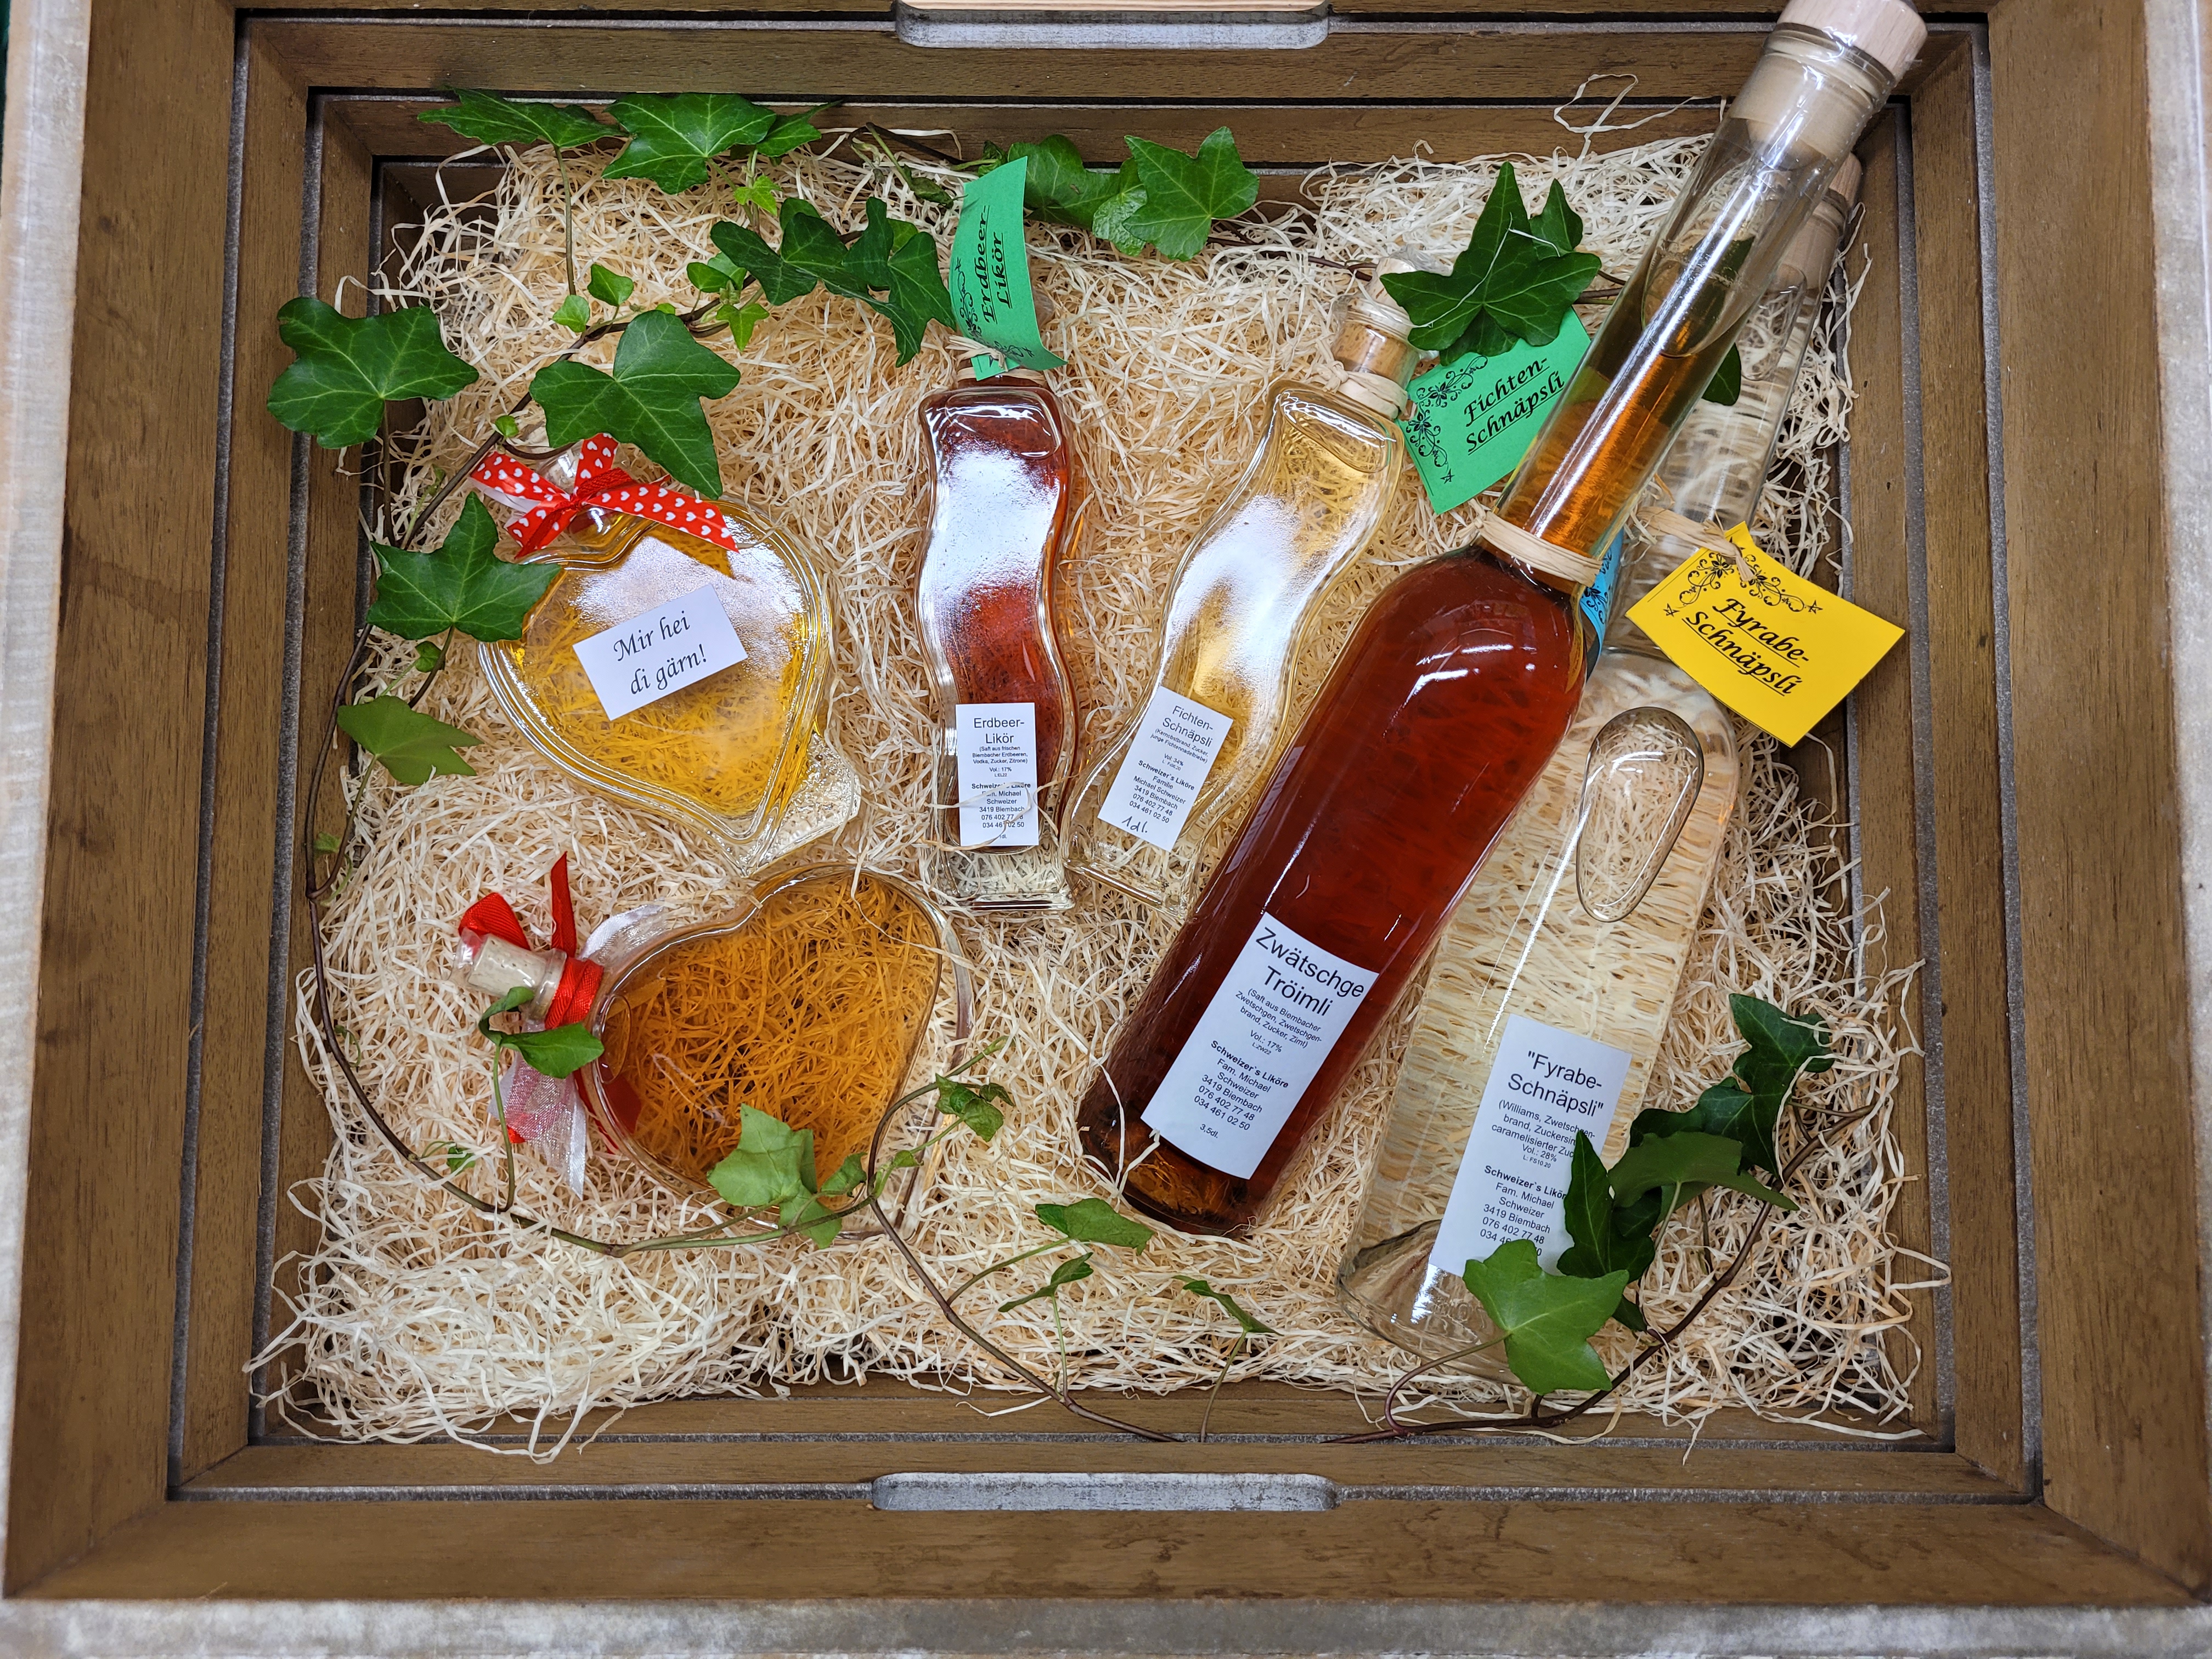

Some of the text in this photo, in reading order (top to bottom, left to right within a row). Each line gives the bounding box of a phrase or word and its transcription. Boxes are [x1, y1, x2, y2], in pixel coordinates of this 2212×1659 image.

[974, 205, 995, 324] Erdbeer-
[991, 232, 1010, 308] Likör
[1464, 358, 1547, 427] Fichten-
[1466, 370, 1565, 452] Schnäpsli
[613, 610, 691, 661] Mir hei
[1712, 597, 1809, 662] Fyrabe-
[1685, 611, 1803, 695] Schnäpsli
[630, 644, 707, 695] di gärn!
[974, 718, 1024, 728] Erdbeer-
[1163, 718, 1213, 747] Schnäpsli
[1172, 706, 1214, 730] Fichten-
[985, 733, 1014, 743] Likör
[1150, 733, 1208, 764] junge Fichtennadeltriebe)
[1155, 729, 1208, 757] (Kernobstbrand, Zucker,
[1133, 775, 1186, 804] Michael Schweizer
[1153, 776, 1173, 789] Familie
[1176, 777, 1195, 791] Liköre
[1129, 800, 1141, 809] 034
[1133, 793, 1144, 802] 076
[1145, 800, 1156, 808] 402
[1135, 785, 1178, 810] 3419 Biembach
[1255, 927, 1364, 998] Zwätschge
[1263, 965, 1334, 1017] Tröimli
[1235, 990, 1322, 1042] Zwetschgen, Zwetschgen-
[1248, 989, 1321, 1032] (Saft aus Biembacher
[1240, 1006, 1308, 1048] brand, Zucker, Zimt)
[1250, 1030, 1282, 1052] Vol.: 17%
[1217, 1058, 1272, 1093] Fam. Michael
[1262, 1072, 1289, 1088] Liköre
[1527, 1050, 1602, 1089] "Fyrabe-
[1202, 1074, 1262, 1113] 3419 Biembach
[1217, 1072, 1260, 1099] Schweizer
[1508, 1073, 1604, 1117] Schnäpsli"
[1194, 1096, 1250, 1130] 034 461 02 50
[1199, 1085, 1255, 1121] 076 402 77 48
[1499, 1099, 1541, 1122] (Williams,
[1200, 1124, 1218, 1139] 3,5dl.
[1503, 1114, 1531, 1132] brand,
[1492, 1124, 1558, 1152] caramelisierter
[1522, 1144, 1557, 1162] Vol.: 28%
[1496, 1182, 1554, 1209] Fam. Michael
[1499, 1197, 1545, 1218] Schweizer
[1544, 1186, 1567, 1200] Likör
[1482, 1217, 1545, 1244] 076 402 77 48
[1483, 1204, 1550, 1234] 3419 Biembach
[1480, 1229, 1497, 1242] 034
